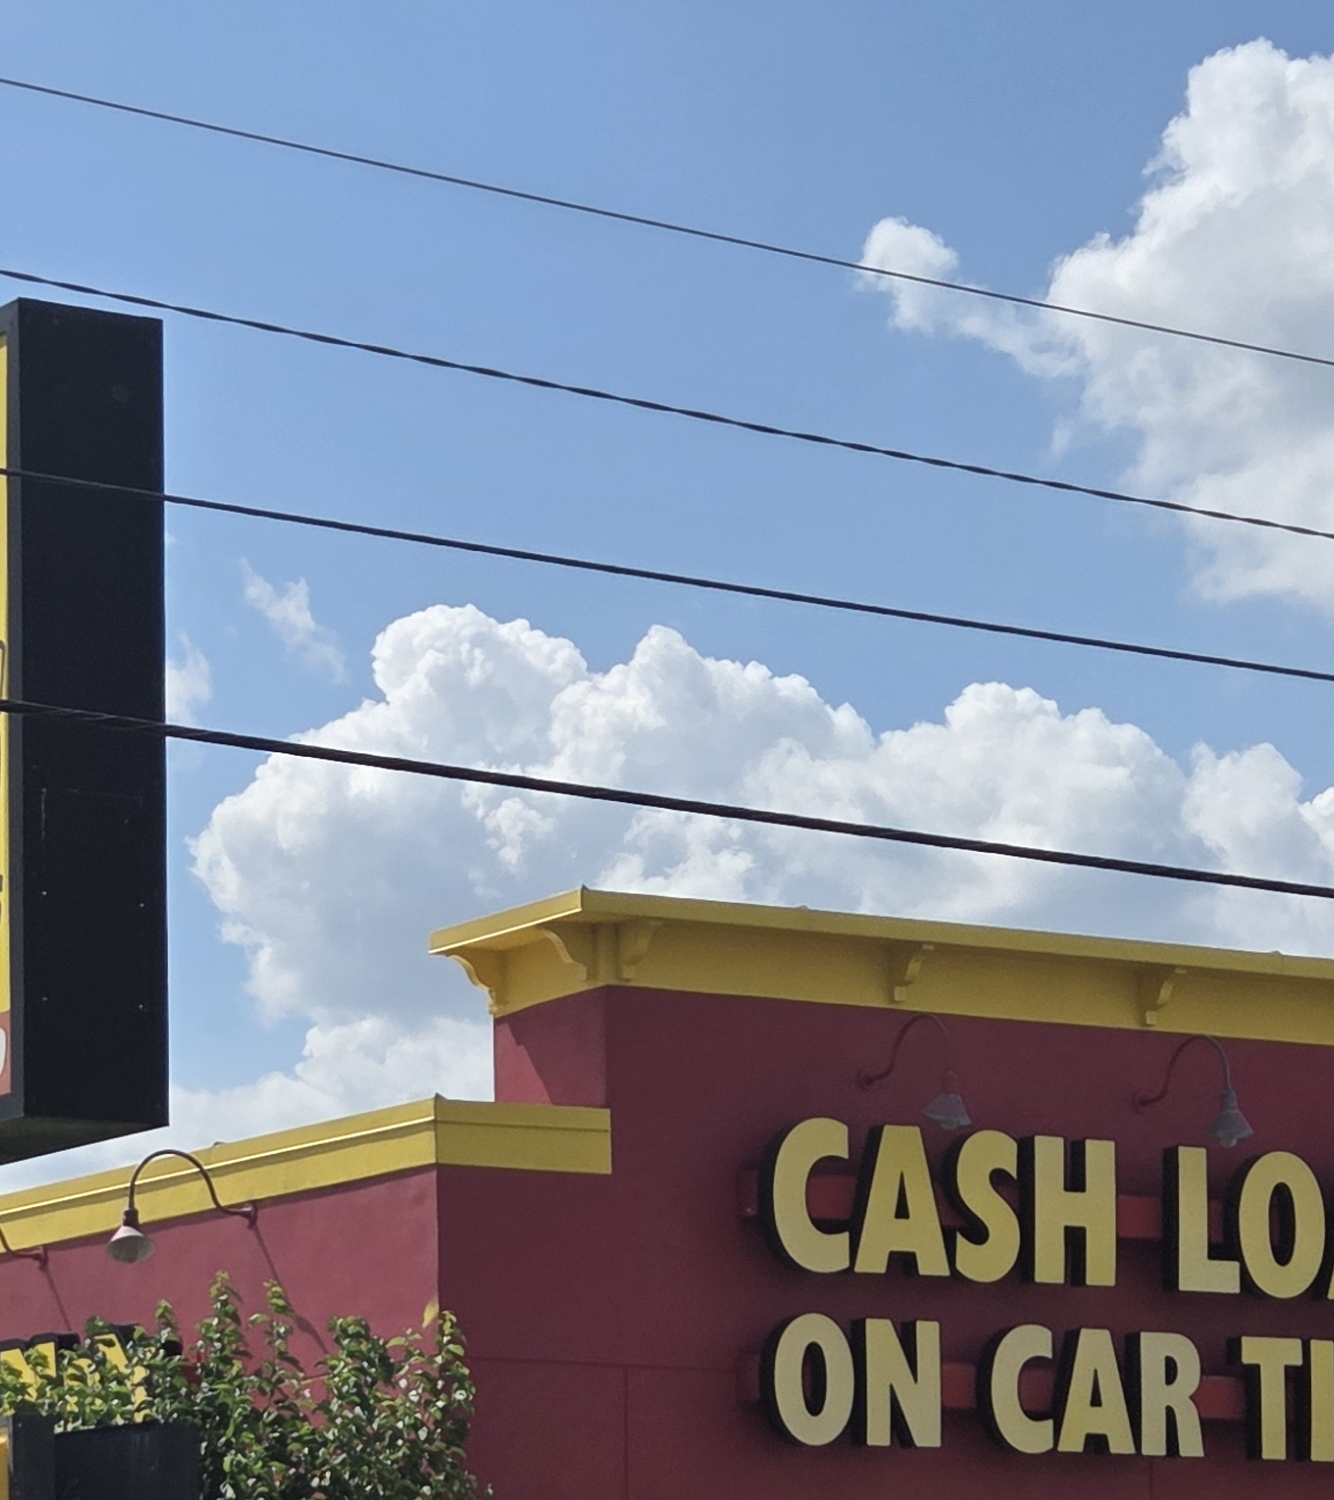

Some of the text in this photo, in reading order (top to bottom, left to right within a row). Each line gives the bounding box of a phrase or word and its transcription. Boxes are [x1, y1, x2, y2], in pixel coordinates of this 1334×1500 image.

[773, 1117, 1117, 1286] CASH
[774, 1313, 942, 1447] ON
[991, 1324, 1204, 1457] CAR
